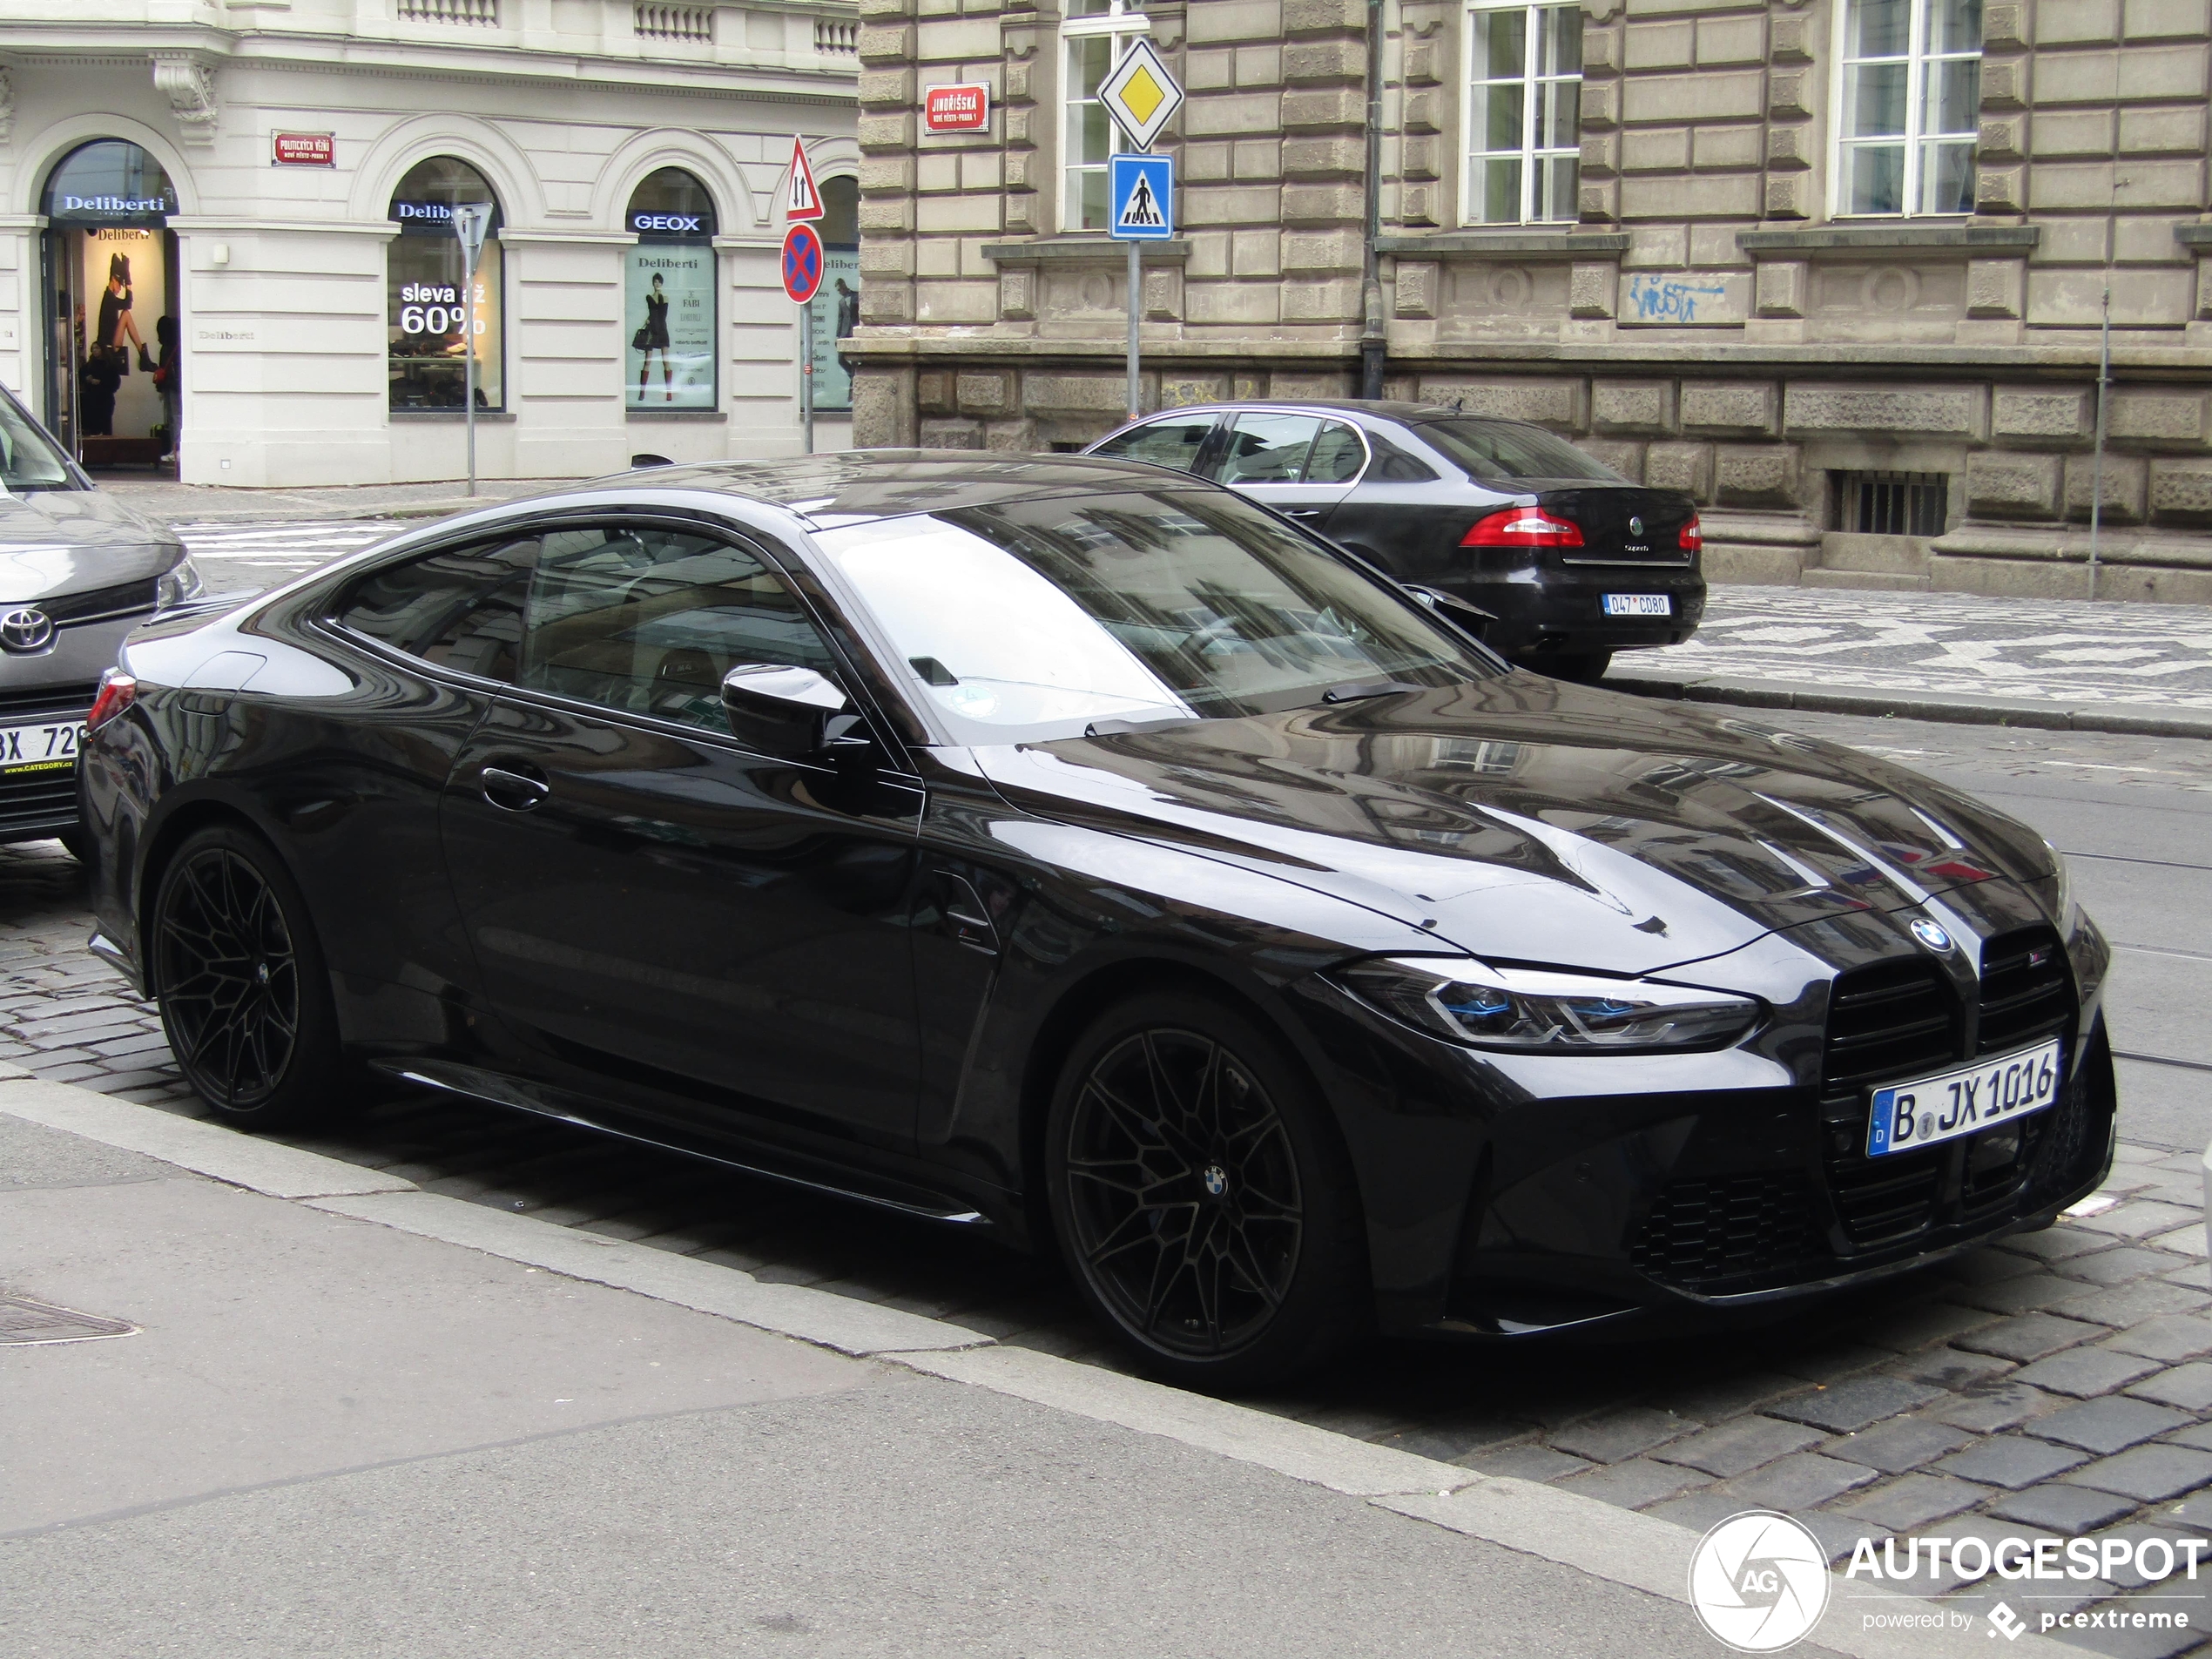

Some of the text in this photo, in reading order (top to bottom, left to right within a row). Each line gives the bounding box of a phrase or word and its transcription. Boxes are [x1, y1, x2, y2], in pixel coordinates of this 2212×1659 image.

[932, 93, 977, 112] JINDŘIŠSKÁ
[280, 139, 314, 151] POLITICKÝCH
[65, 196, 165, 212] Deliberti
[399, 204, 454, 219] Delib
[634, 215, 700, 232] GEOX
[638, 257, 698, 269] Deliberti
[823, 260, 860, 269] eliber
[402, 283, 455, 303] sleva
[683, 299, 700, 308] FABI
[401, 306, 486, 335] 60%
[199, 330, 255, 341] Deliberti
[1612, 597, 1631, 613] 047
[1639, 597, 1665, 613] CD80
[4, 762, 73, 774] www.CATEGORY.cz
[1875, 1052, 2053, 1143] D B JX 1016
